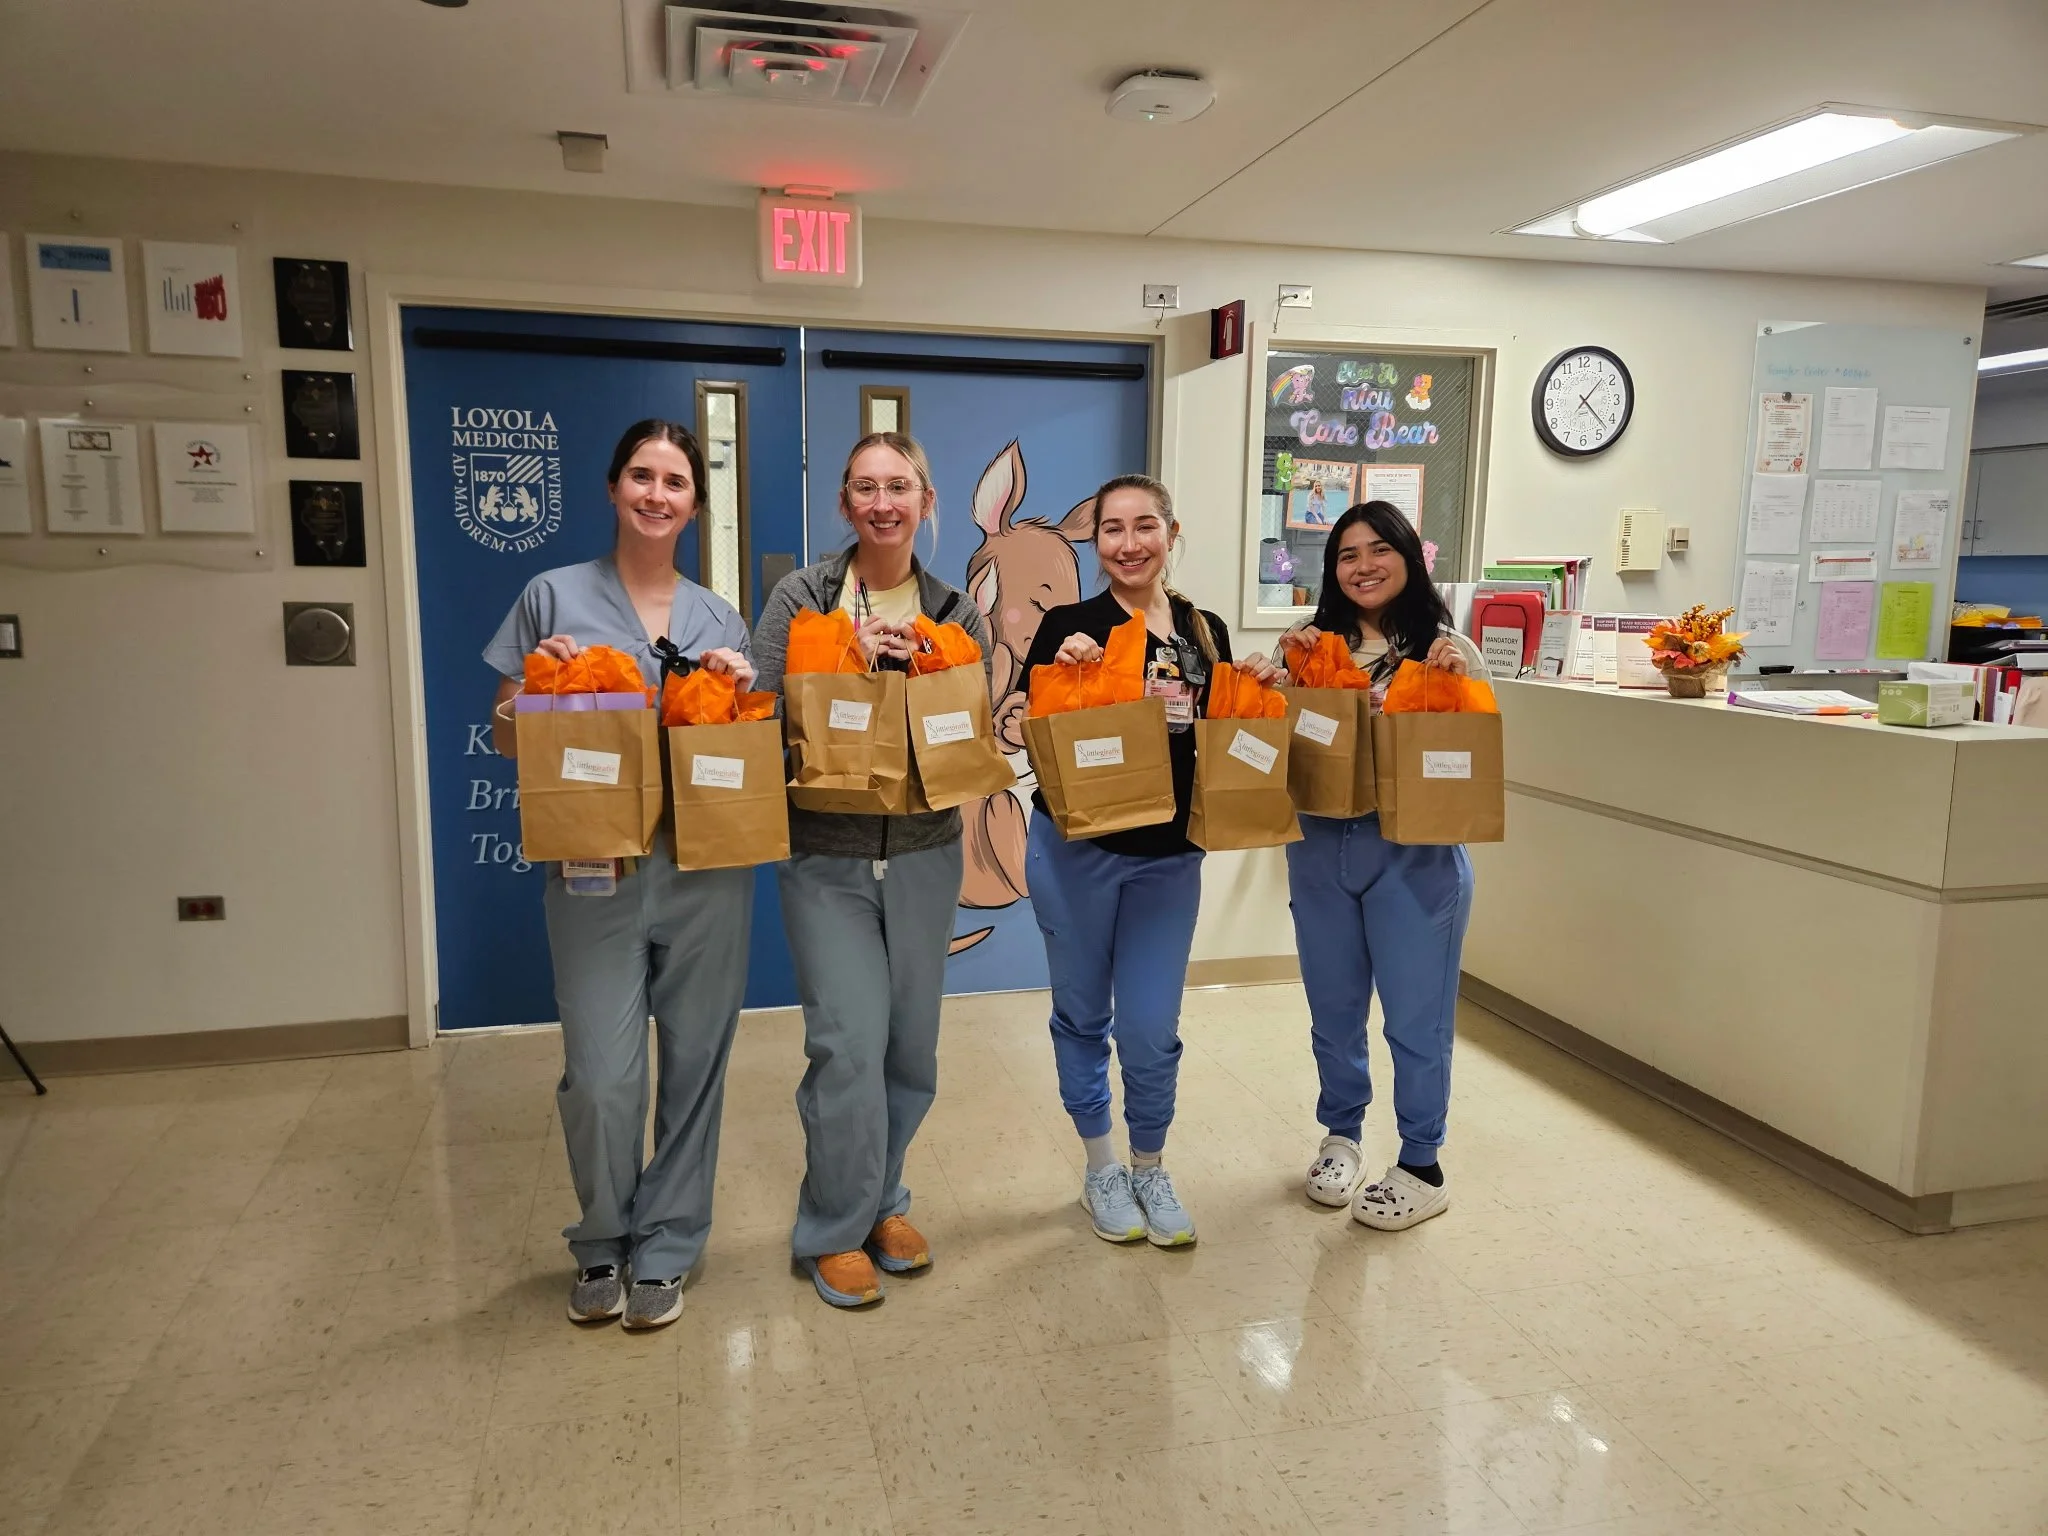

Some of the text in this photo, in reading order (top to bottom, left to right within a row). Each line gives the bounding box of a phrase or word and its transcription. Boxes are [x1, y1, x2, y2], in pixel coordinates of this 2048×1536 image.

[773, 207, 850, 274] EXIT
[1578, 356, 1590, 368] 12
[1598, 361, 1602, 372] 1
[1561, 363, 1572, 374] 11
[1549, 378, 1561, 390] 10
[1608, 374, 1616, 386] 2
[1545, 398, 1553, 410] 9
[1613, 394, 1620, 406] 3
[451, 406, 558, 432] LOYOLA
[1550, 418, 1558, 429] 8
[1608, 413, 1616, 424] 4
[1290, 408, 1439, 449] Care Bear
[1595, 429, 1603, 440] 5
[452, 430, 559, 451] MEDICINE
[1563, 432, 1570, 443] 7
[1579, 435, 1587, 446] 6
[474, 470, 506, 482] 1870
[1485, 636, 1518, 645] MANDATORY
[1486, 648, 1516, 656] EDUCATION
[1488, 659, 1514, 668] MATERIAL
[472, 832, 533, 873] Tog
